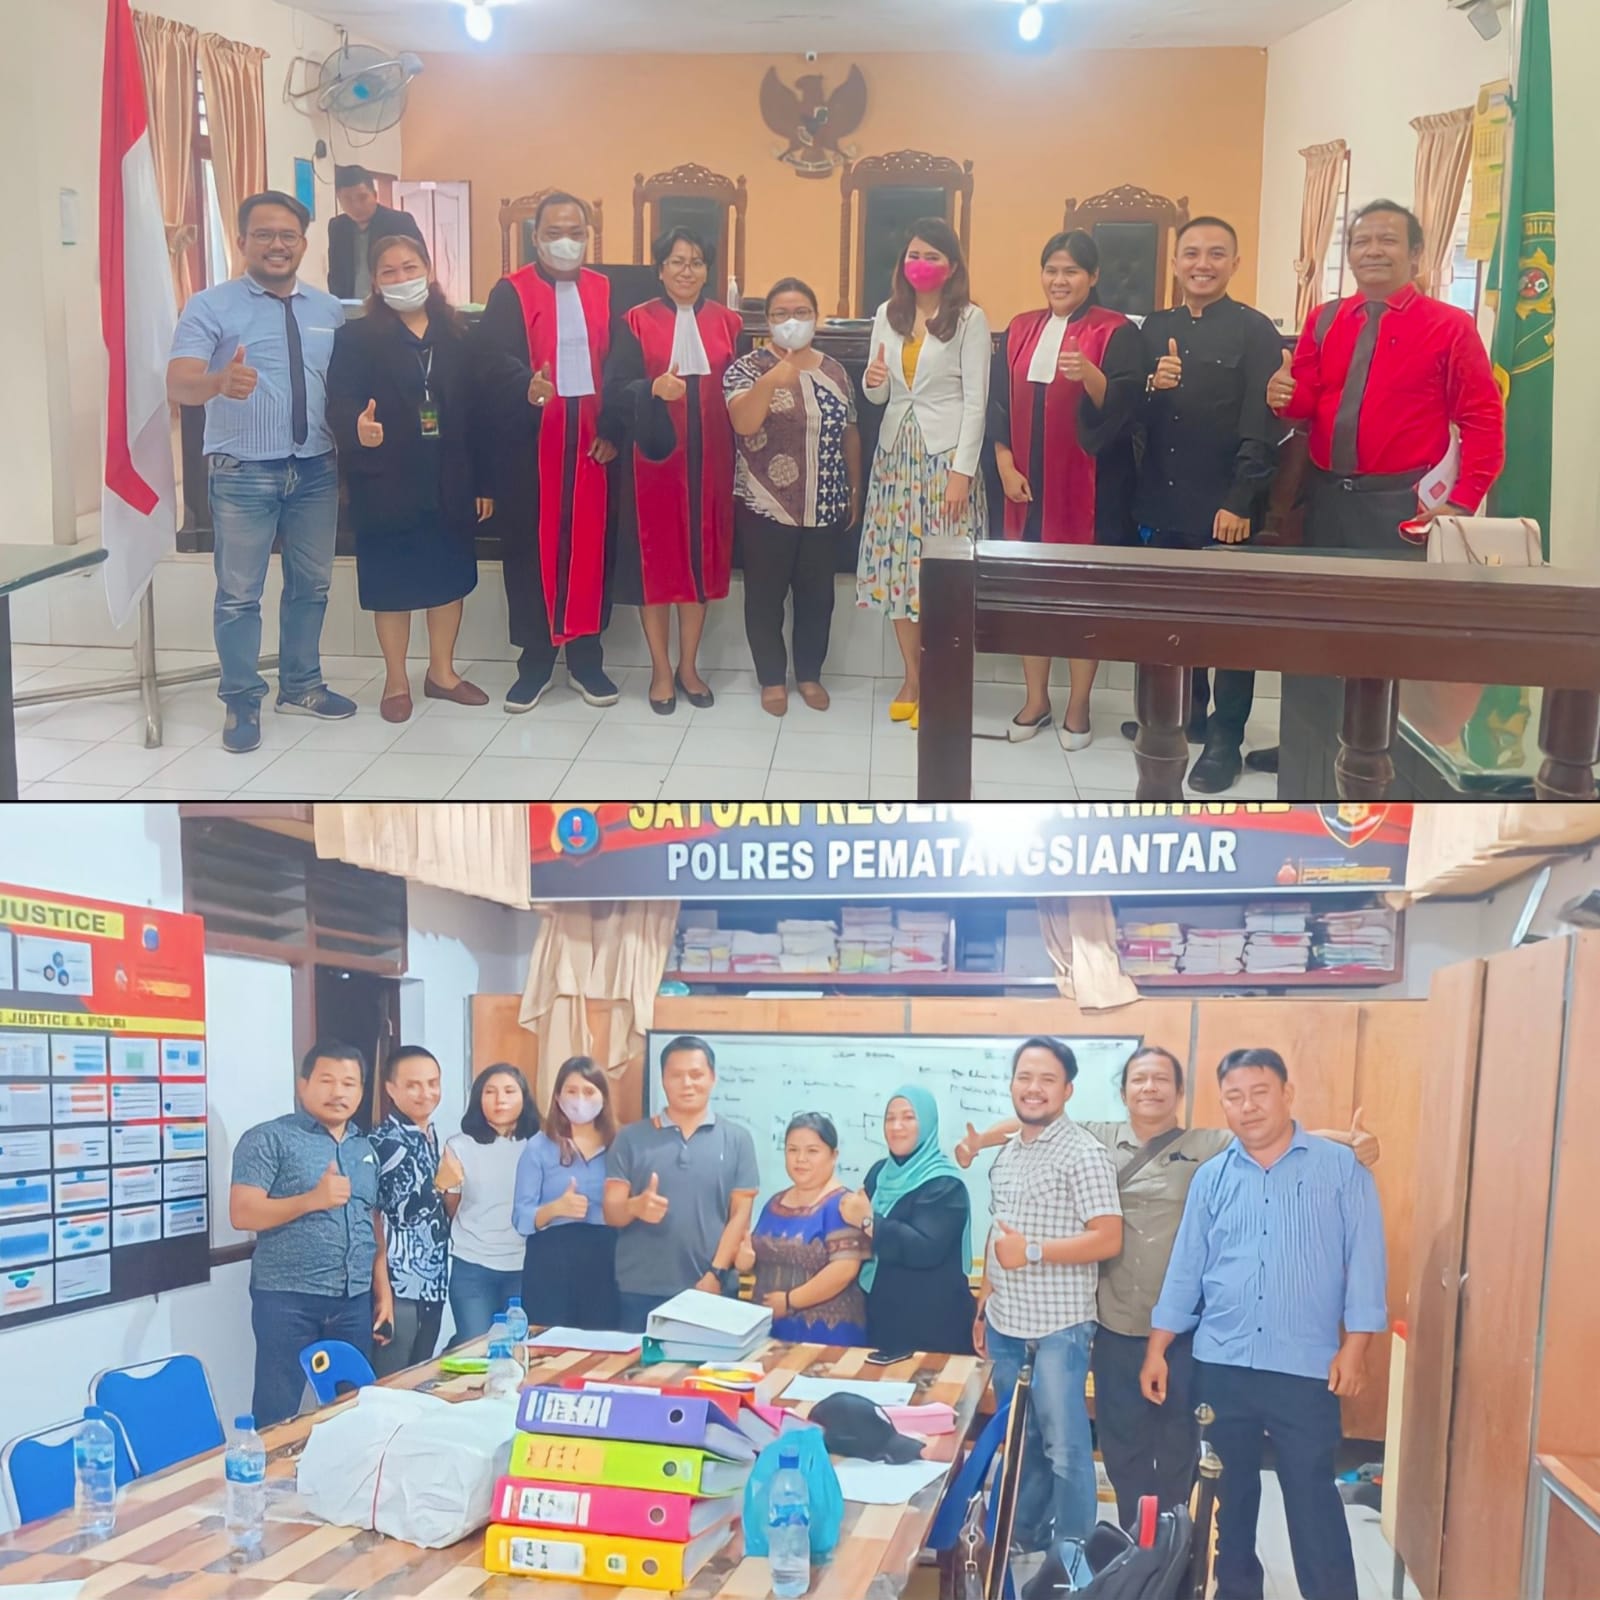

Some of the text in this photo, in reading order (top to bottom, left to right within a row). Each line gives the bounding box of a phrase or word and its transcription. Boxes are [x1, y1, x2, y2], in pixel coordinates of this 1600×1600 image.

[667, 830, 1238, 881] POLRES PEMATANGSIANTAR
[0, 899, 107, 933] JUSTICE
[9, 1012, 69, 1026] JUSTICE
